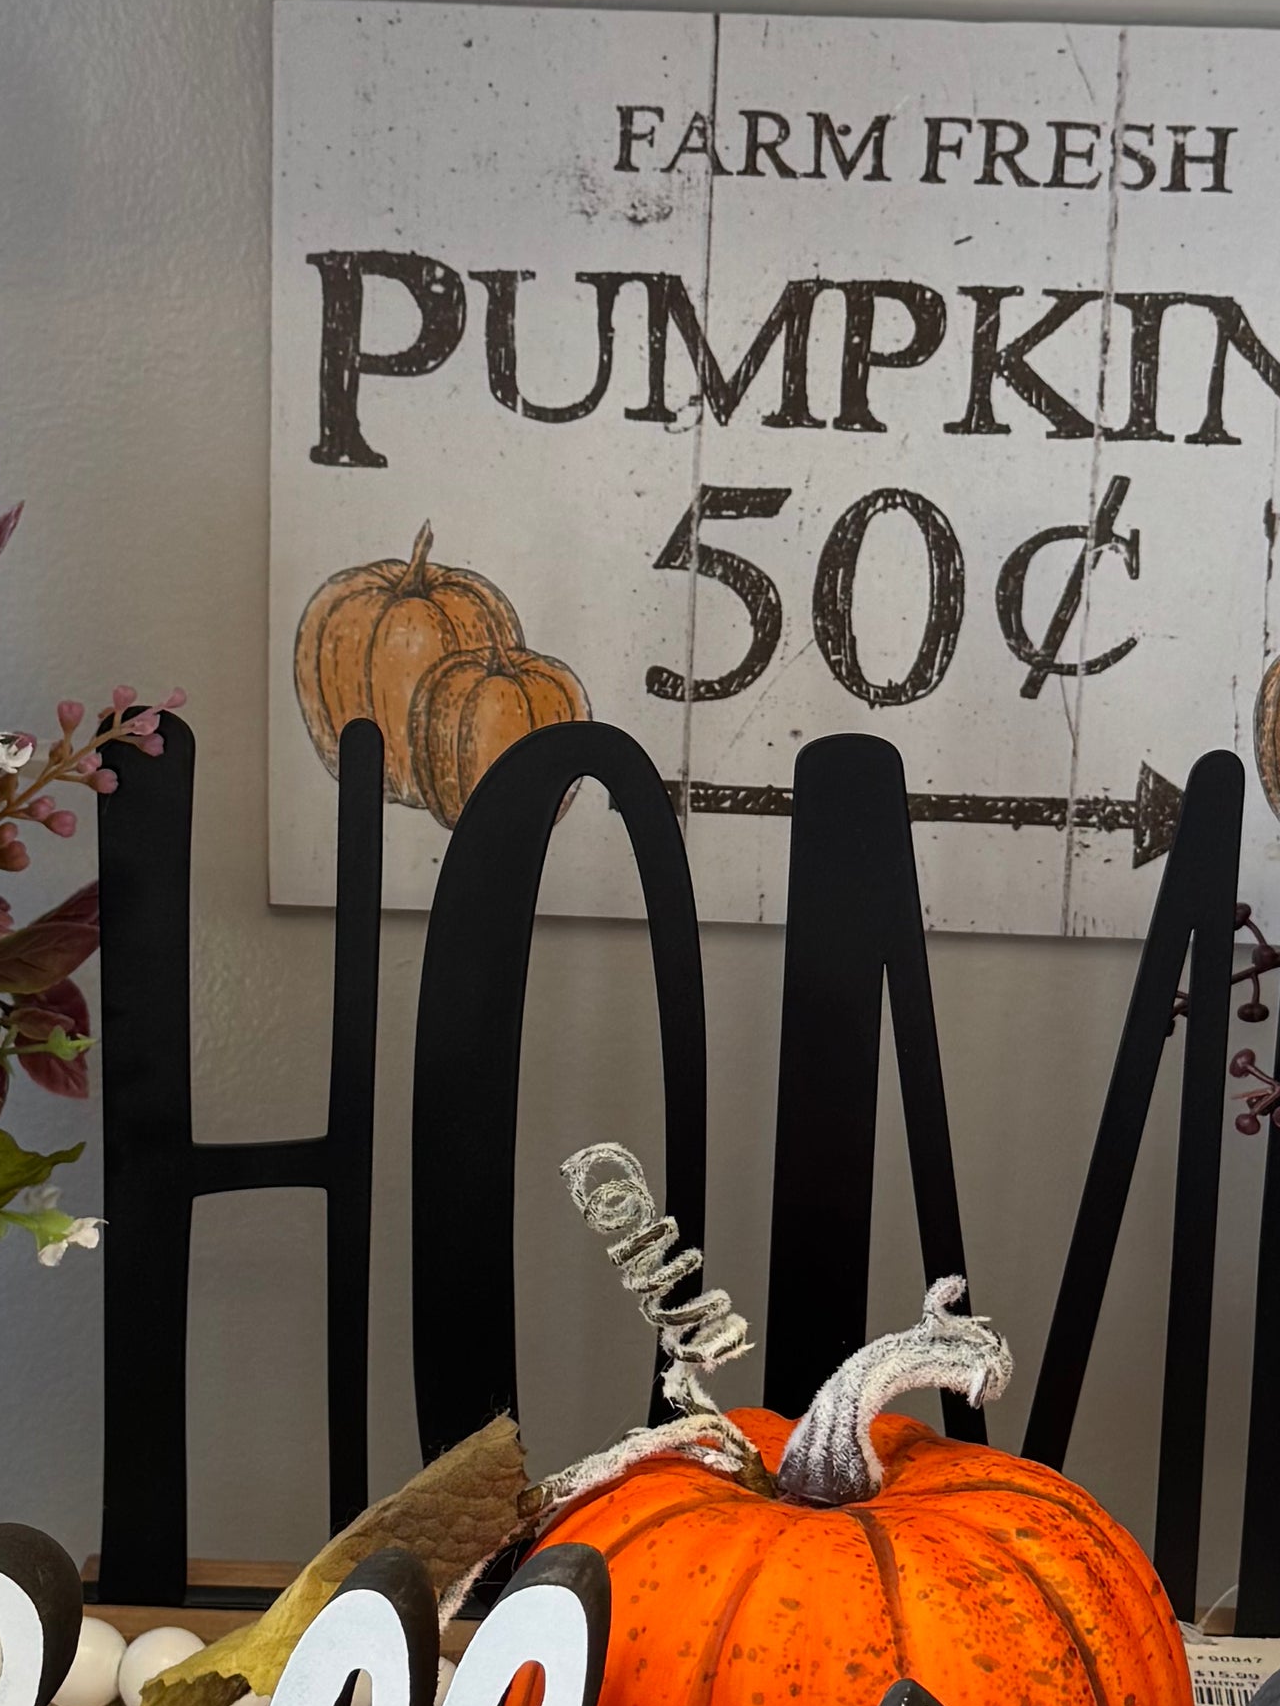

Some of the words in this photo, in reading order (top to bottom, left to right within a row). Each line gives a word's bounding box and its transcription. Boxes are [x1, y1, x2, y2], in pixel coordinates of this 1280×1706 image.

[613, 104, 892, 182] FARM
[920, 116, 1239, 194] FRESH
[645, 474, 1140, 709] 50¢
